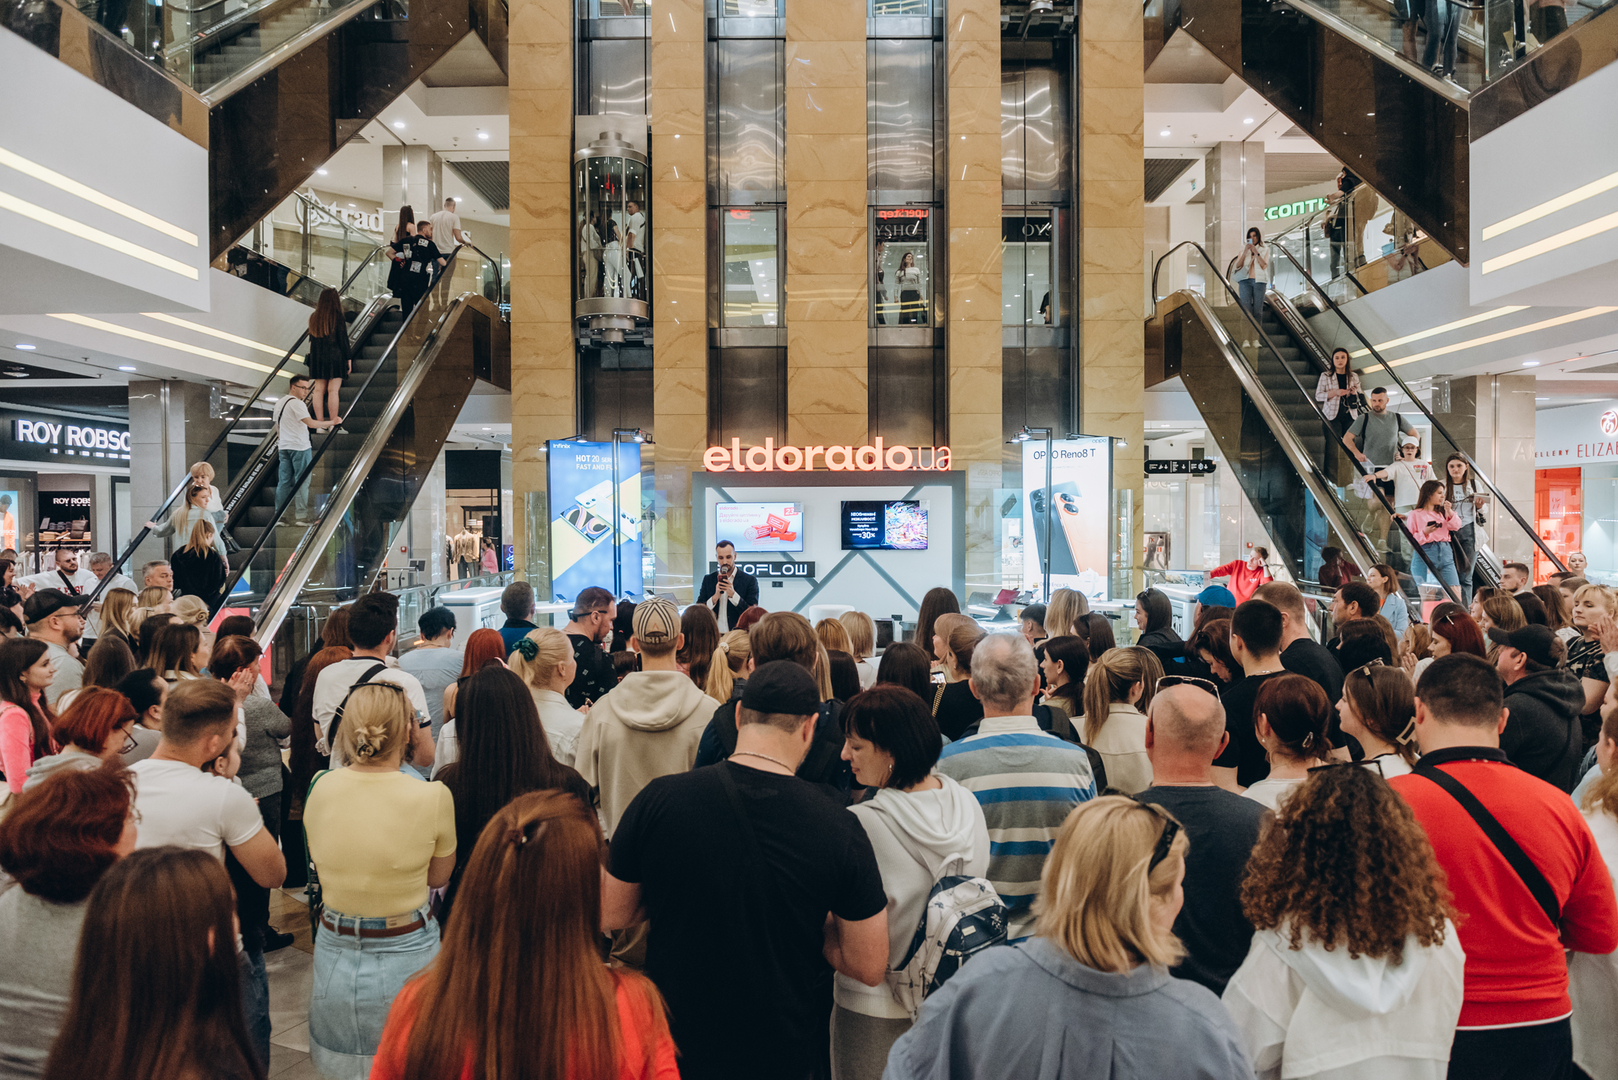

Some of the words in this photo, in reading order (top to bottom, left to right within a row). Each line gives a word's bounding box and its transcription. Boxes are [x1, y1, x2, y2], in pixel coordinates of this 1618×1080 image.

[16, 419, 62, 444] ROY
[576, 454, 590, 462] HOT
[703, 436, 952, 472] eldorado.ua
[1034, 450, 1058, 460] OPO
[1060, 448, 1088, 458] Reno8
[1090, 448, 1096, 457] T
[717, 564, 807, 575] OFLOW
